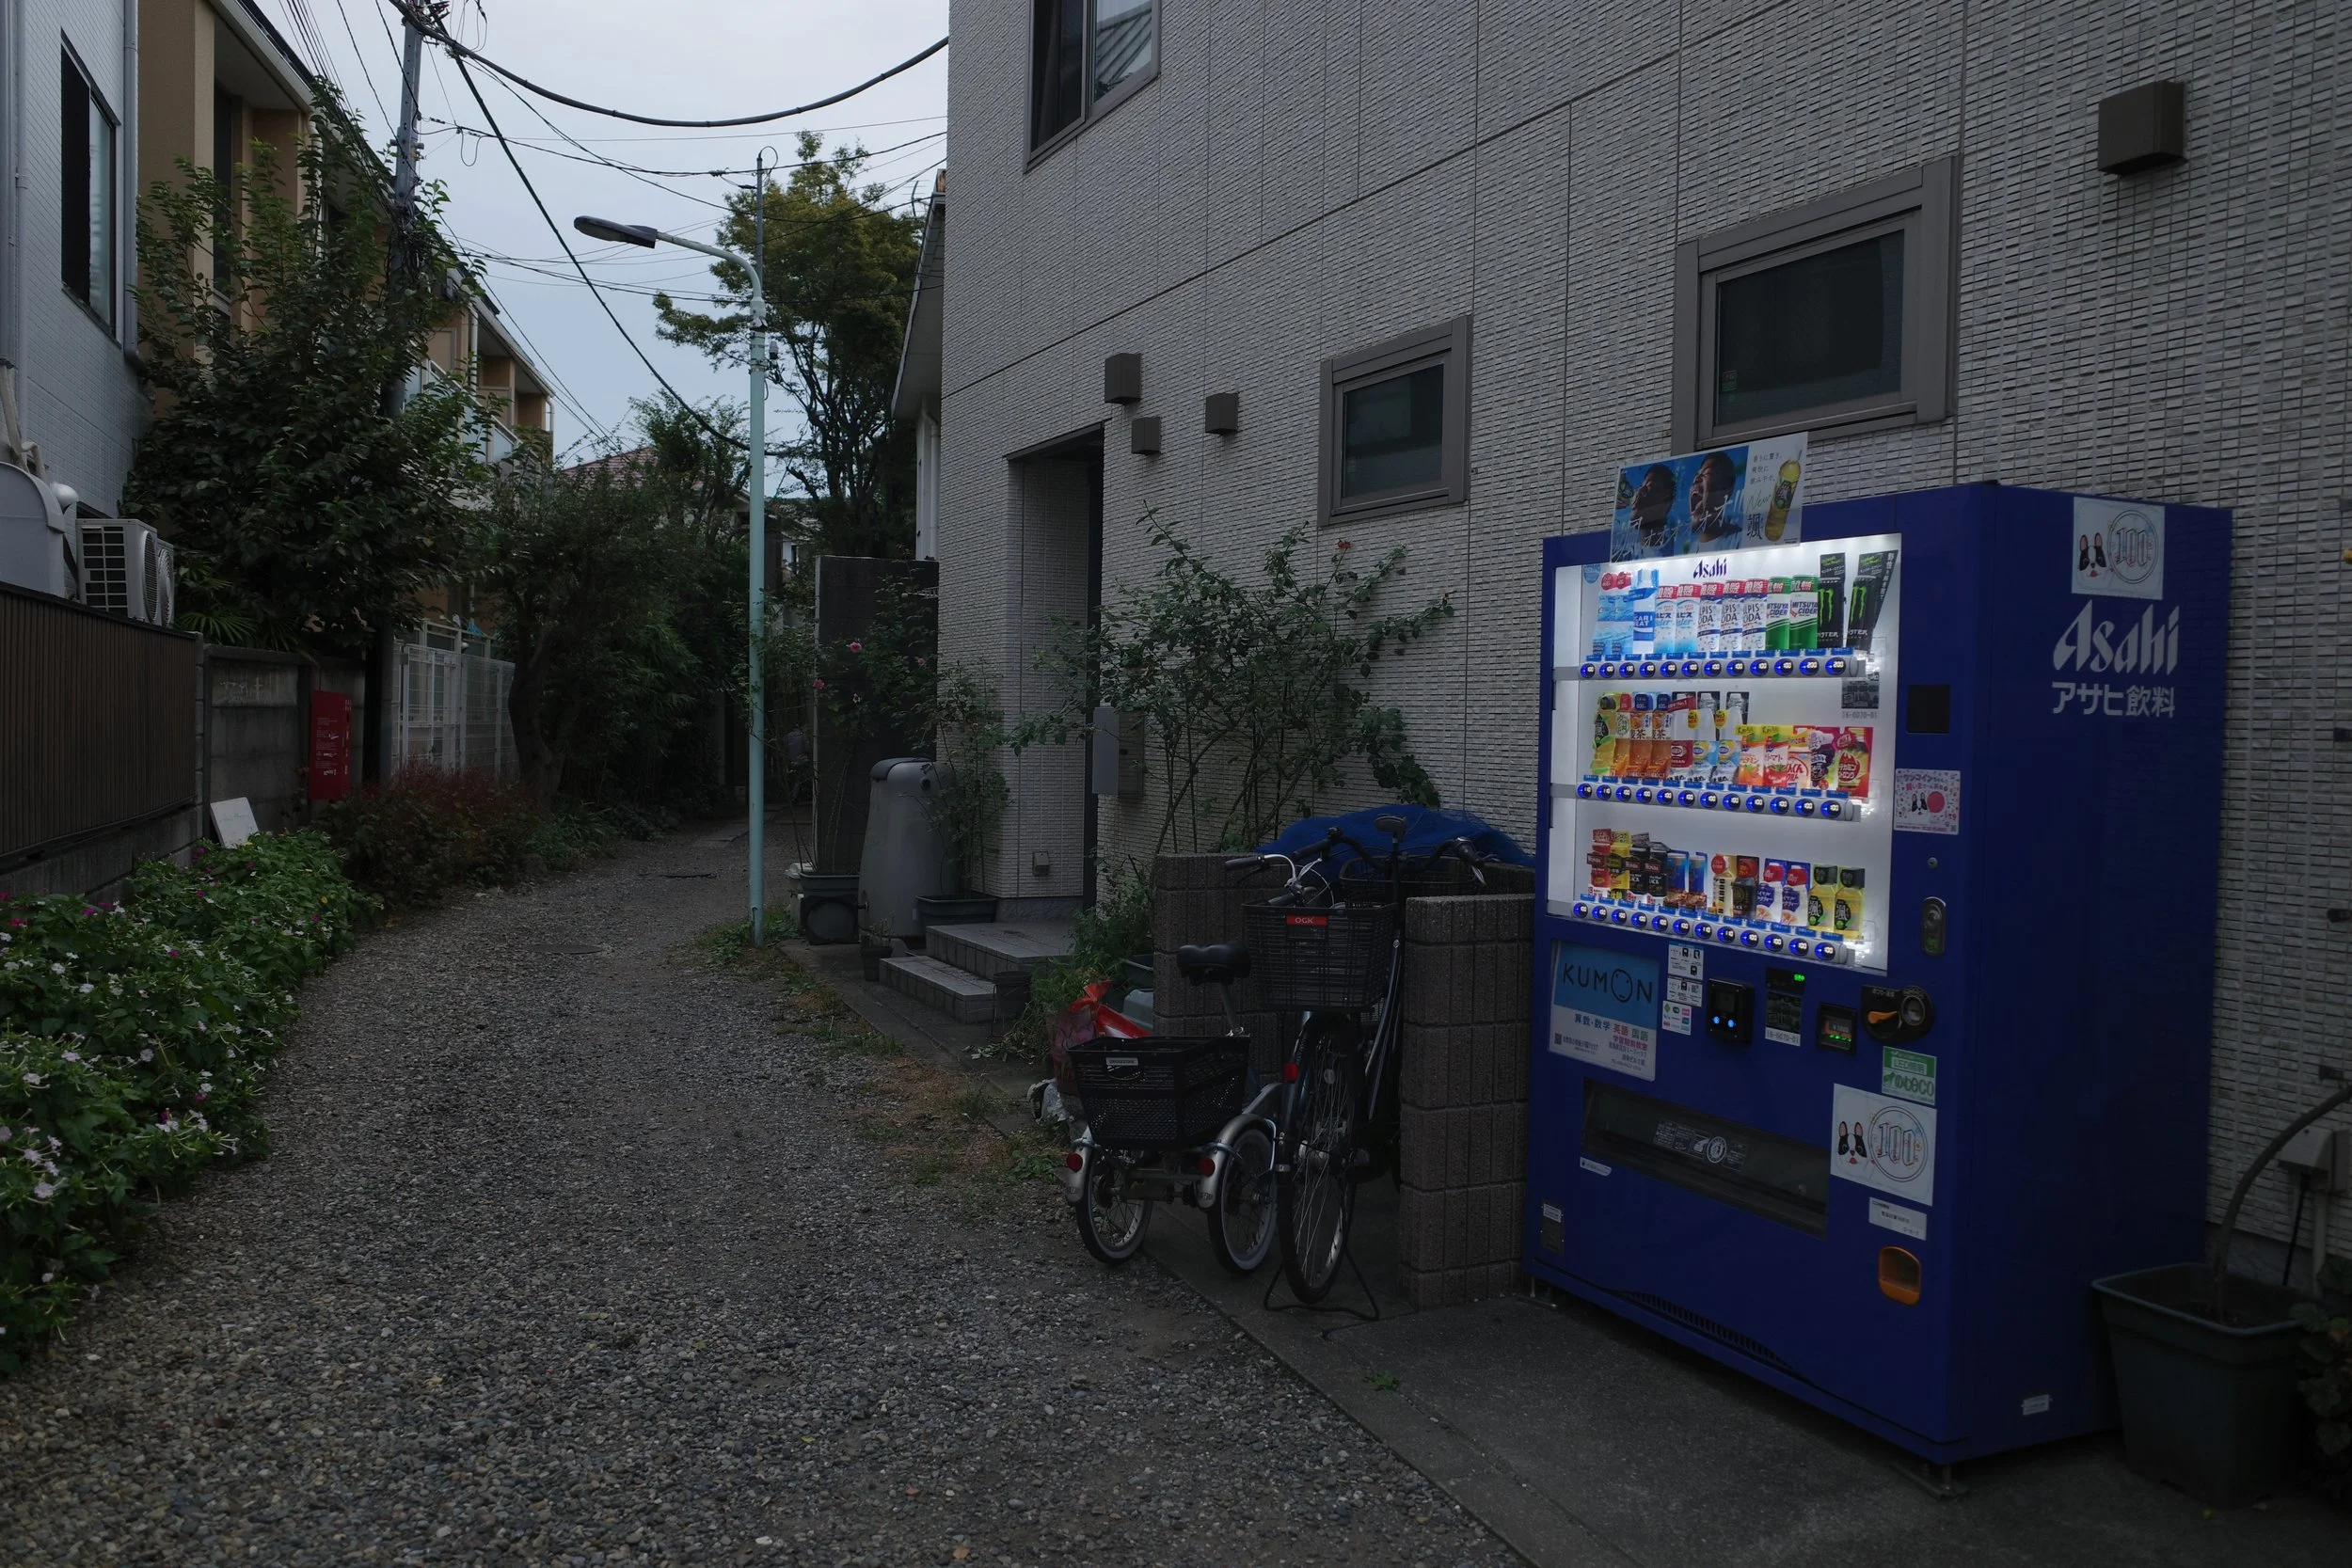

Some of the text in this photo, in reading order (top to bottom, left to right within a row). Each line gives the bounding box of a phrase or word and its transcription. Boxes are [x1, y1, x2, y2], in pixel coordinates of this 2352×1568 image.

[1693, 558, 1727, 578] Asahi
[2053, 598, 2180, 675] Asahi
[2051, 681, 2175, 719] アサヒ飲料
[1563, 962, 1653, 1003] KUMON
[1613, 1022, 1629, 1037] 英語
